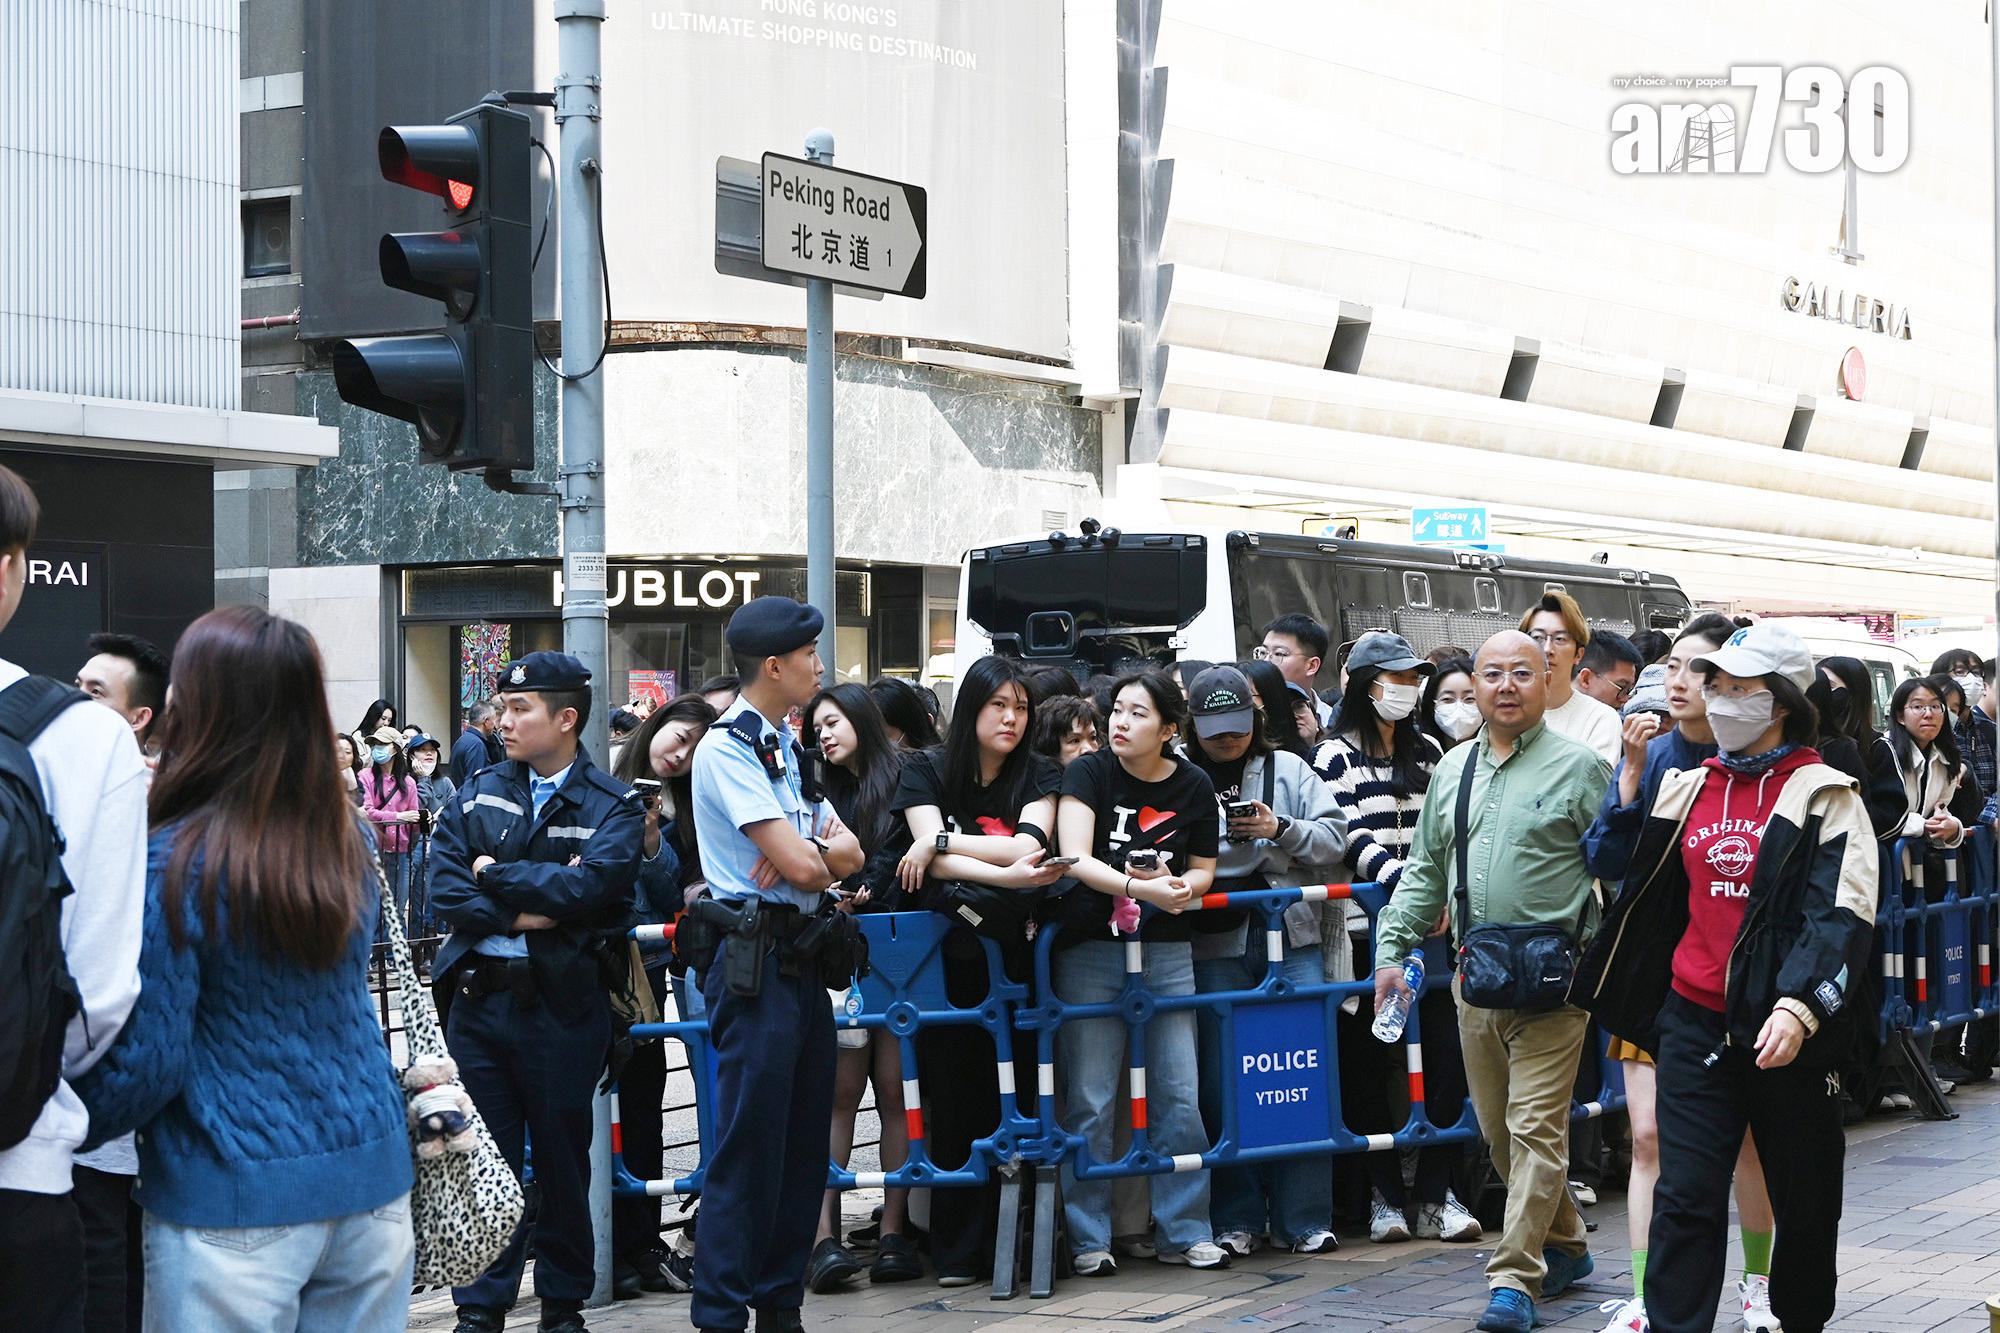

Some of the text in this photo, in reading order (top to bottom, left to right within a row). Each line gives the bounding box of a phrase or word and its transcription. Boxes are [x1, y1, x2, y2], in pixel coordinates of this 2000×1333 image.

[760, 0, 898, 27] HONG KONG'S
[650, 11, 978, 71] ULTIMATE SHOPPING DESTINATION
[770, 170, 891, 222] Peking Road
[791, 222, 893, 272] 北京道 1
[1781, 275, 1913, 341] GALLERIA
[1432, 511, 1469, 522] Subway
[23, 559, 88, 586] RAI
[1109, 805, 1137, 842] I
[1688, 819, 1763, 848] ORIGINA
[1710, 881, 1750, 897] FILA
[1242, 1049, 1318, 1074] POLICE
[1255, 1087, 1309, 1106] YTDIST
